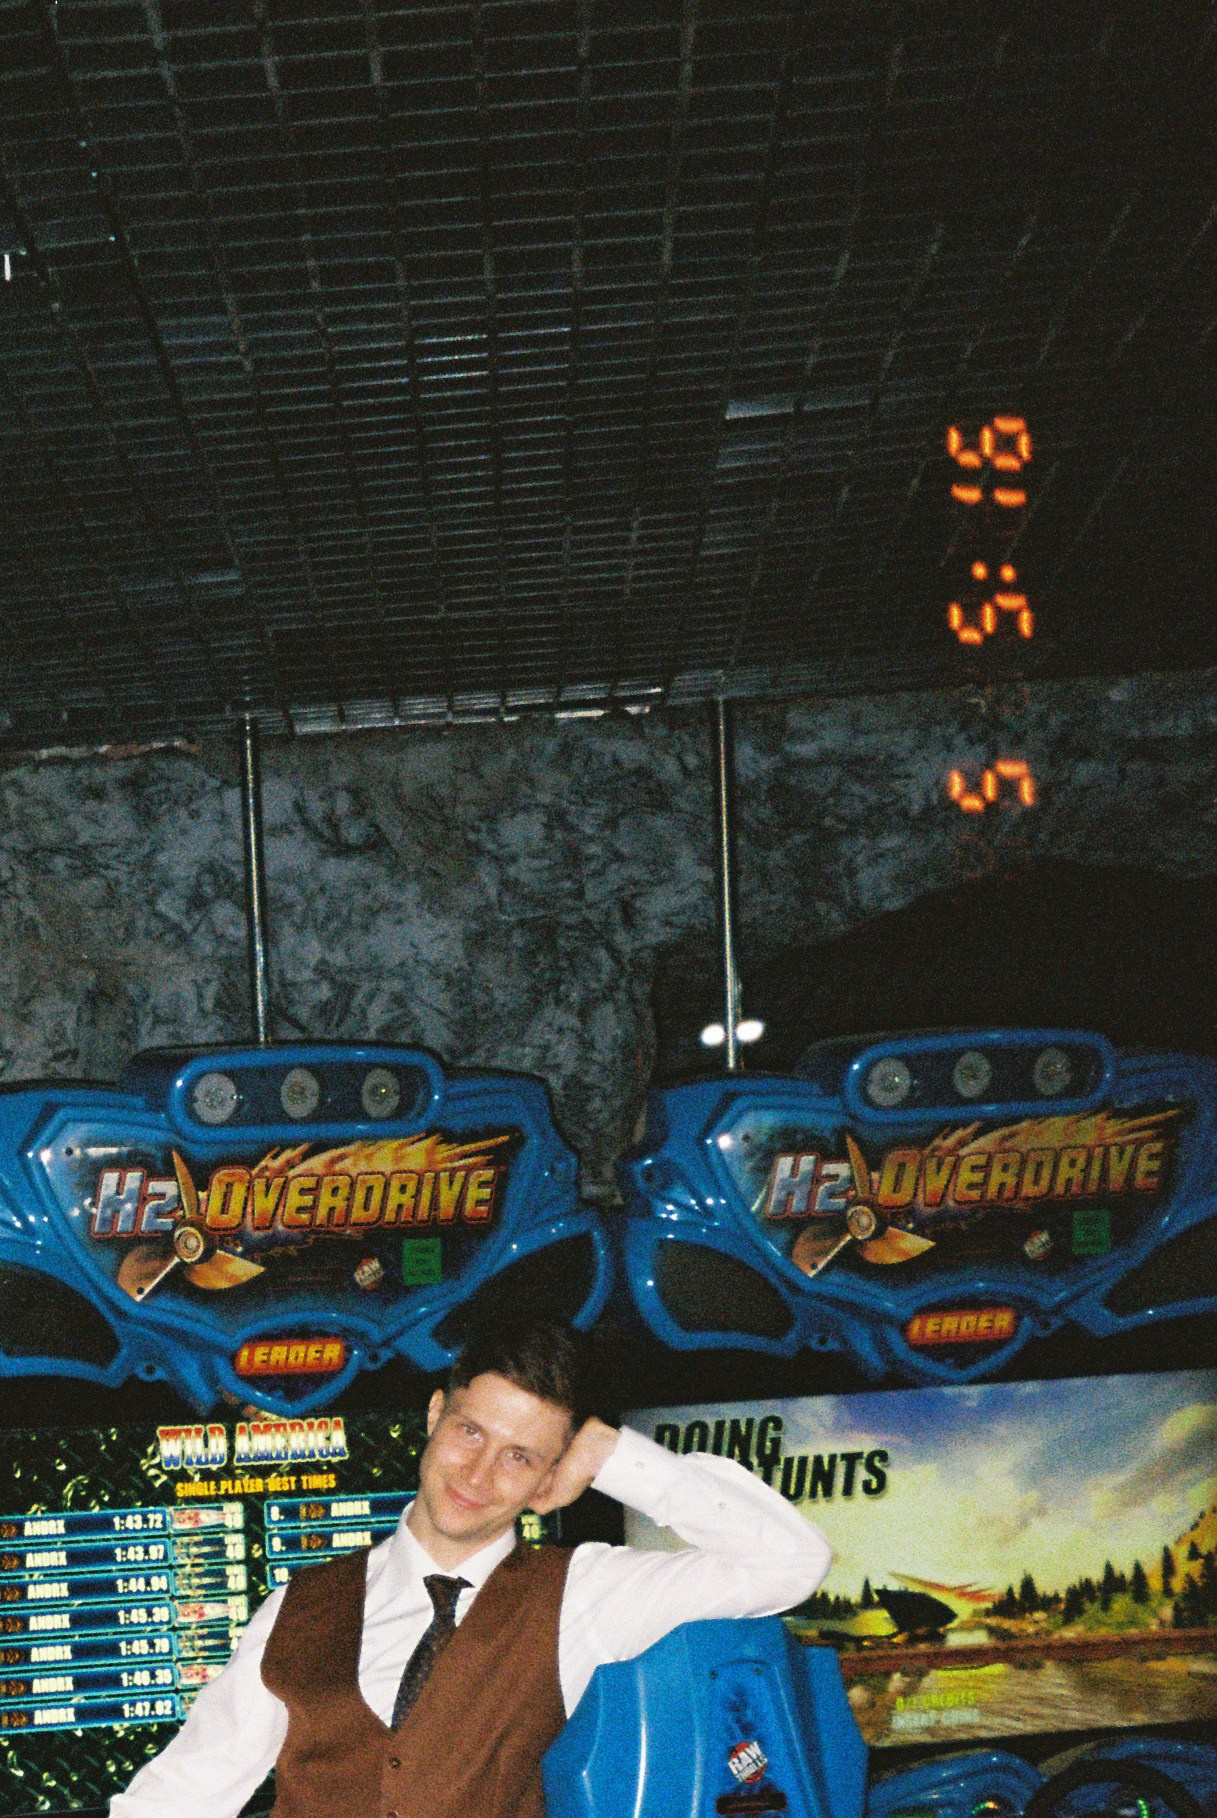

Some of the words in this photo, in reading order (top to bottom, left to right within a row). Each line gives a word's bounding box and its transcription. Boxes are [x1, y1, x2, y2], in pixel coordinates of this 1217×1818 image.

[204, 1165, 497, 1231] OVERDRIVE
[876, 1140, 1166, 1209] OVERDRIVE
[911, 1310, 1011, 1341] LEADER
[240, 1341, 344, 1371] LEADER
[157, 1424, 227, 1470] WILD
[234, 1417, 350, 1465] AMERICA
[652, 1415, 783, 1468] DOING
[176, 1480, 216, 1498] SINGLE
[220, 1477, 264, 1495] PLAYER
[267, 1476, 297, 1492] BEST
[300, 1473, 337, 1490] TIMES
[738, 1449, 890, 1502] TUNTS
[727, 1741, 763, 1776] RAW
